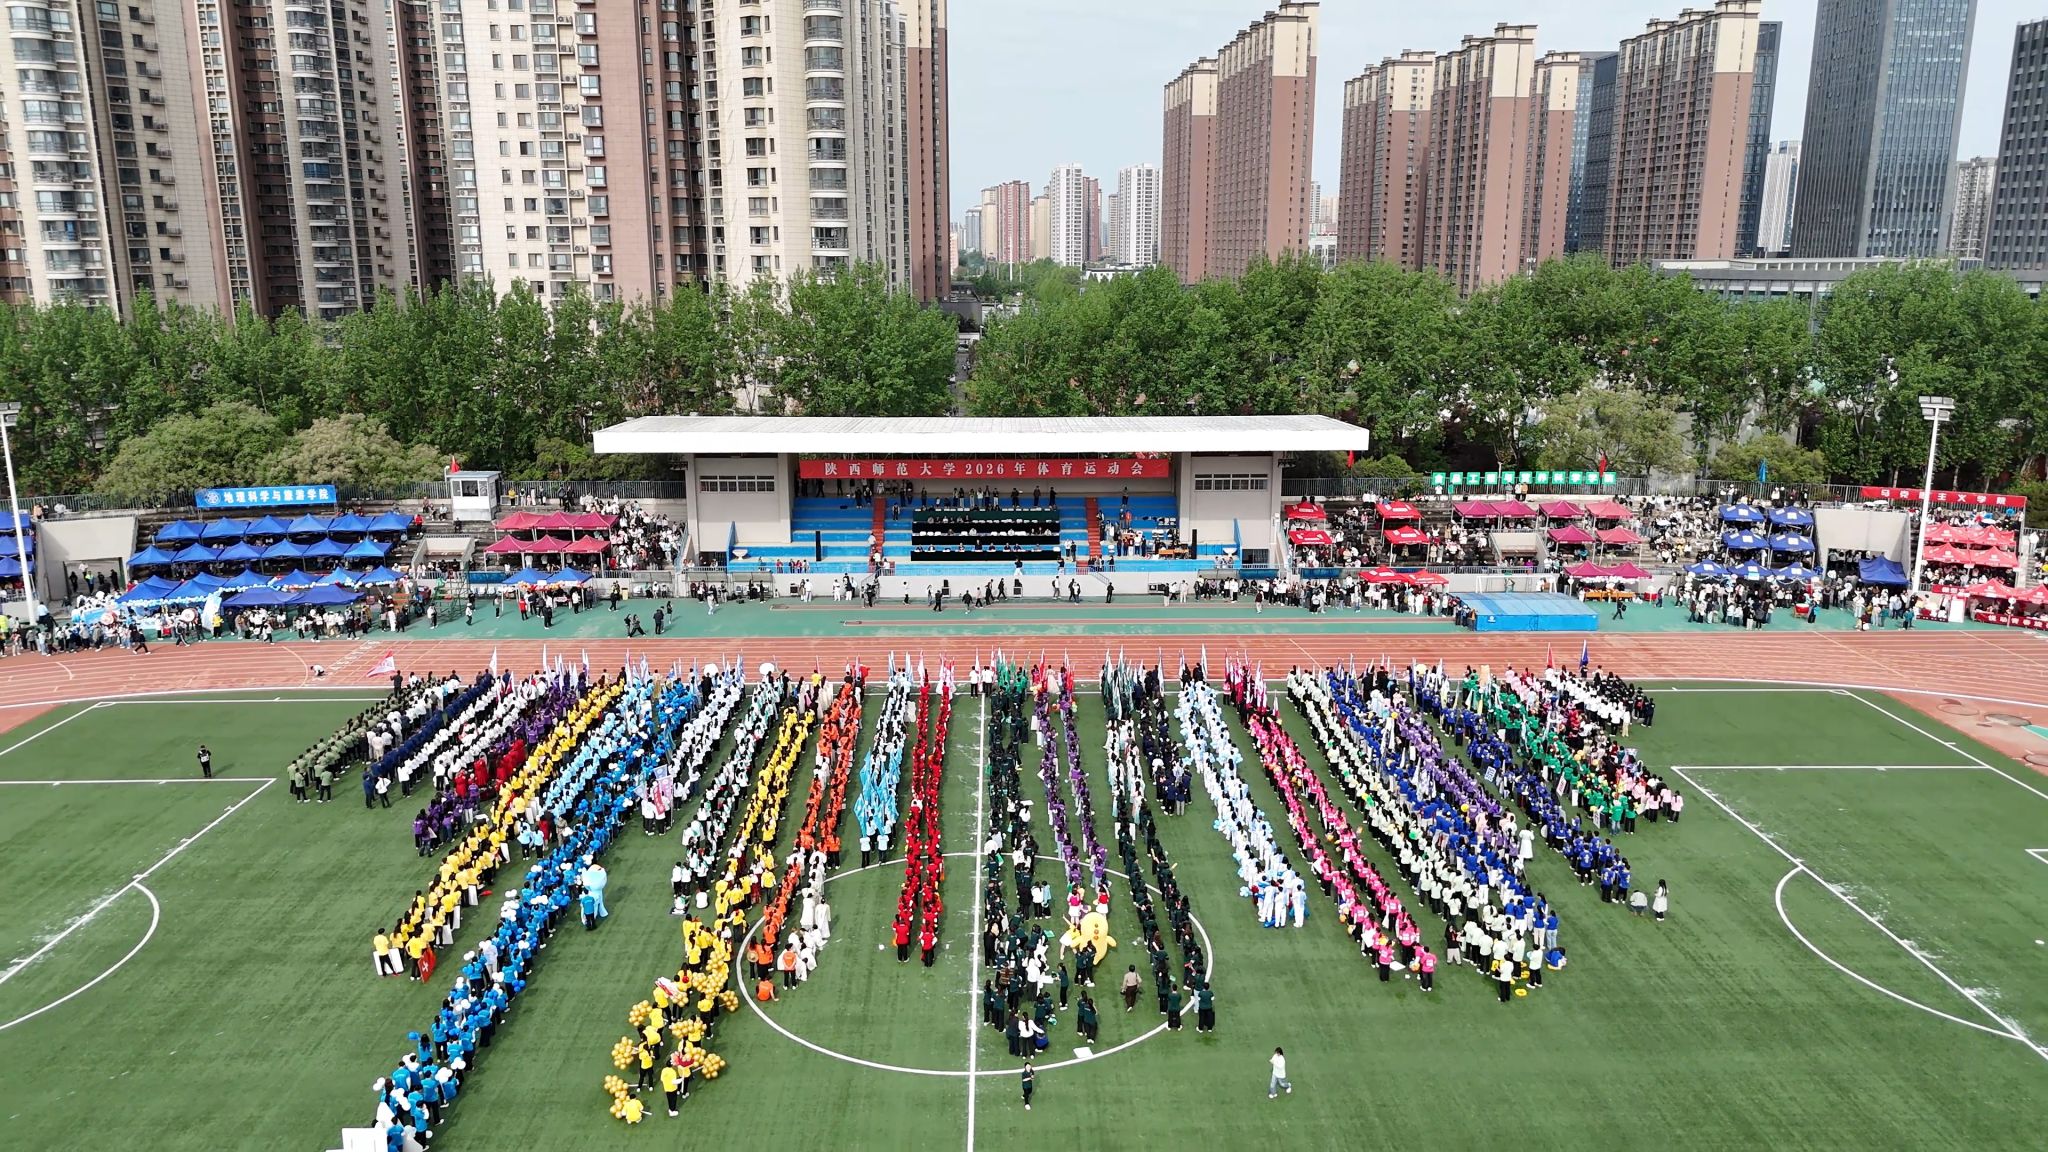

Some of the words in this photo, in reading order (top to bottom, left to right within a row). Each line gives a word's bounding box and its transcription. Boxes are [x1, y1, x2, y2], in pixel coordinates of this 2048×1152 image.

[824, 462, 1143, 475] 陕西师范大学2026年体育运动会
[224, 488, 328, 503] 地理科学与旅游学院
